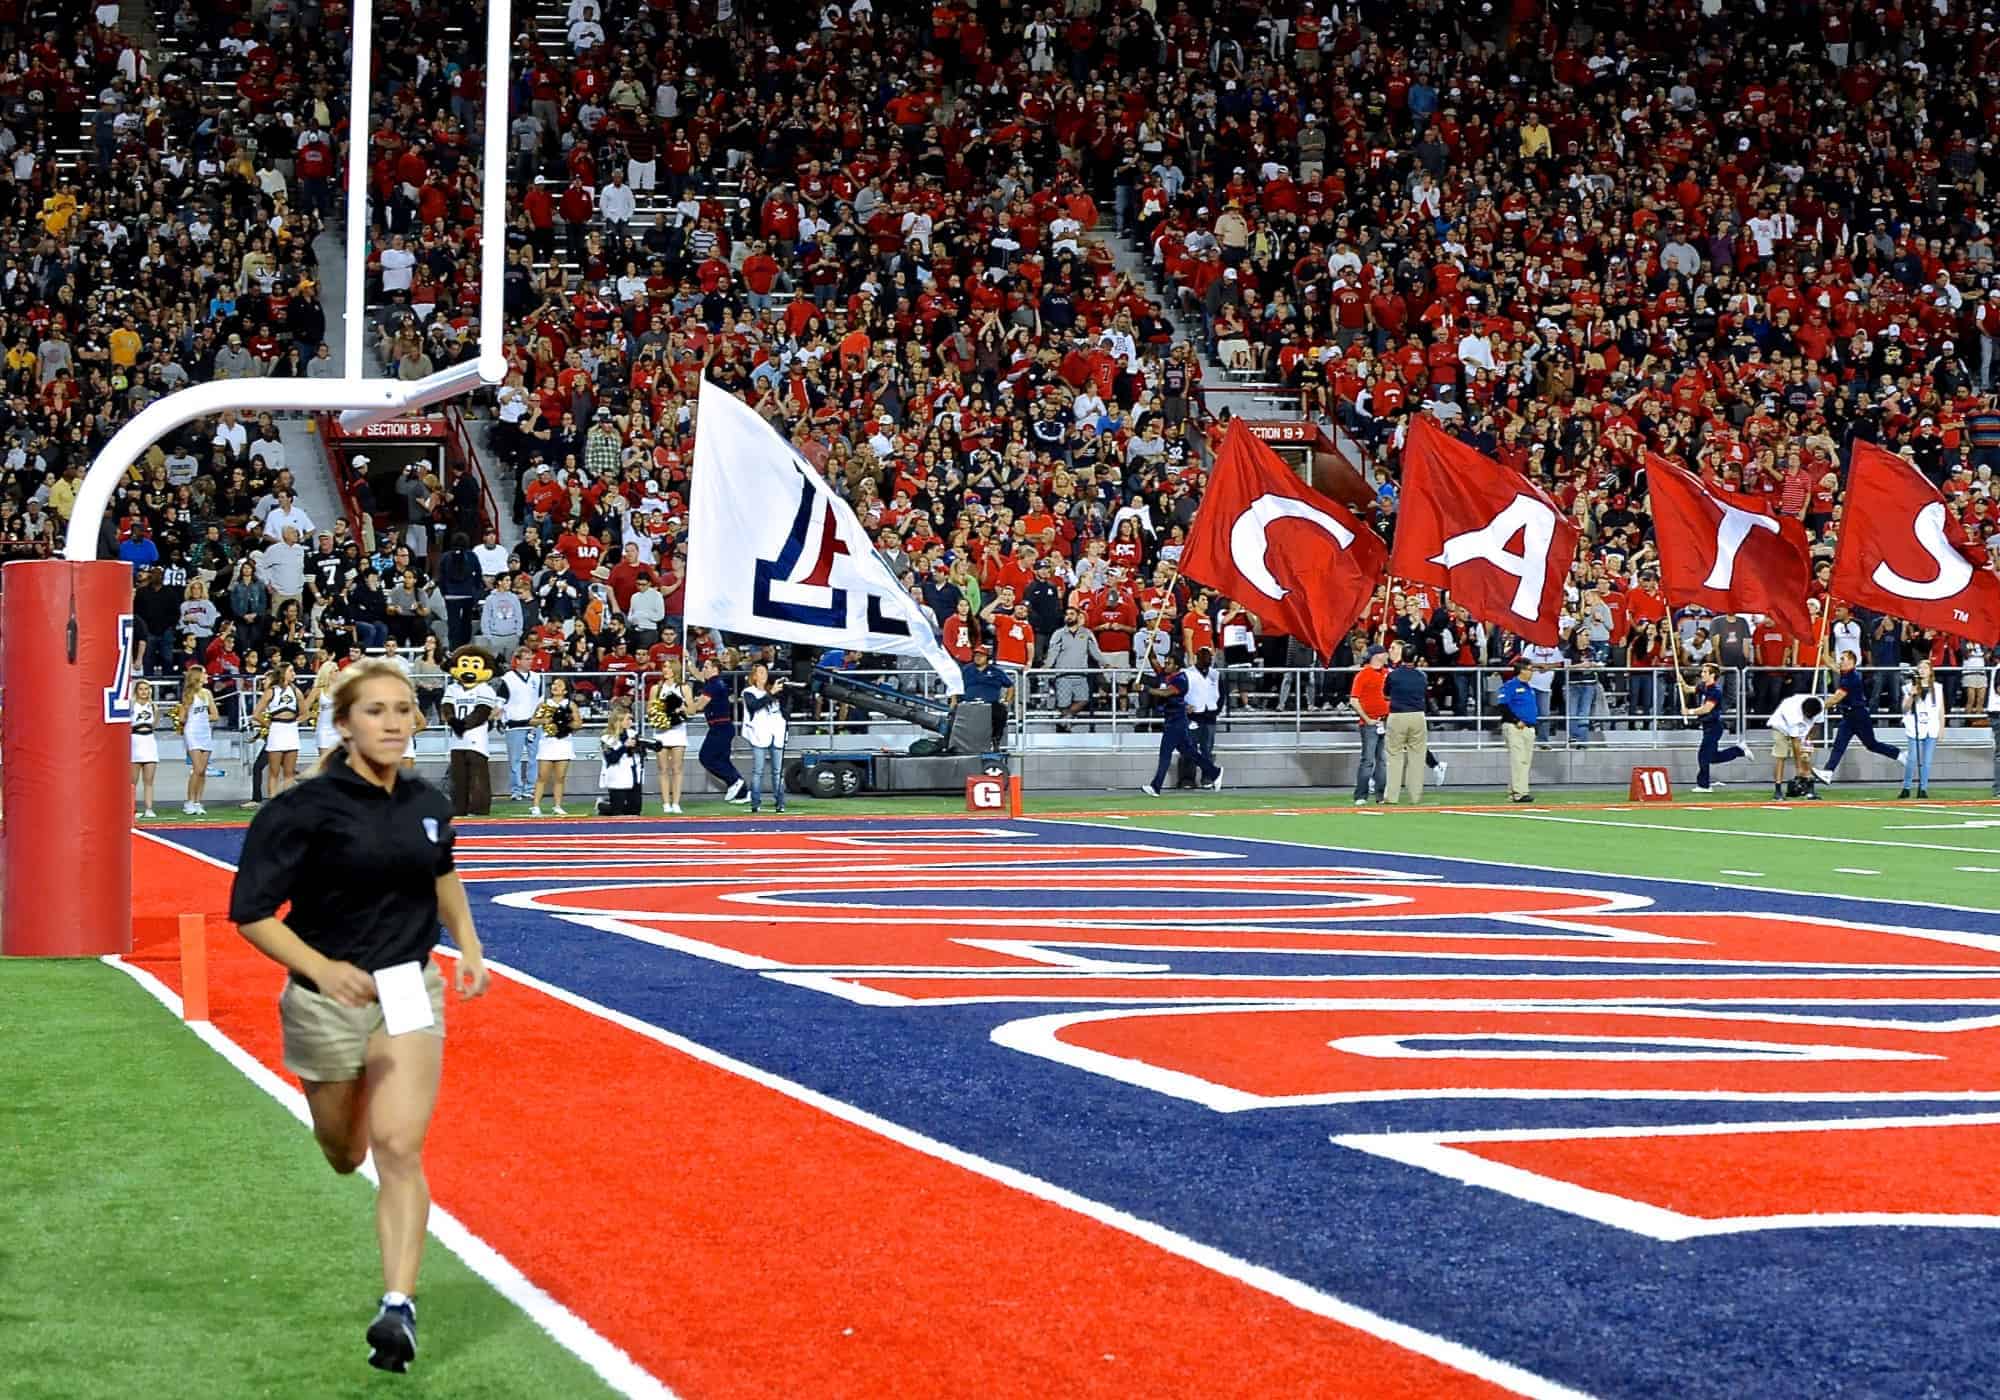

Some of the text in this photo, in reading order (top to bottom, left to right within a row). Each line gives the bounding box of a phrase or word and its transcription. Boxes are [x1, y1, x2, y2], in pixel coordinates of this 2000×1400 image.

[367, 423, 421, 437] SECTION 18
[1283, 427, 1293, 440] 19
[1230, 492, 1356, 601] C
[1429, 492, 1557, 622] A
[1872, 500, 1974, 600] S
[323, 565, 337, 585] 7
[1952, 608, 1970, 623] TM
[973, 782, 1002, 807] G
[1640, 770, 1668, 796] 10
